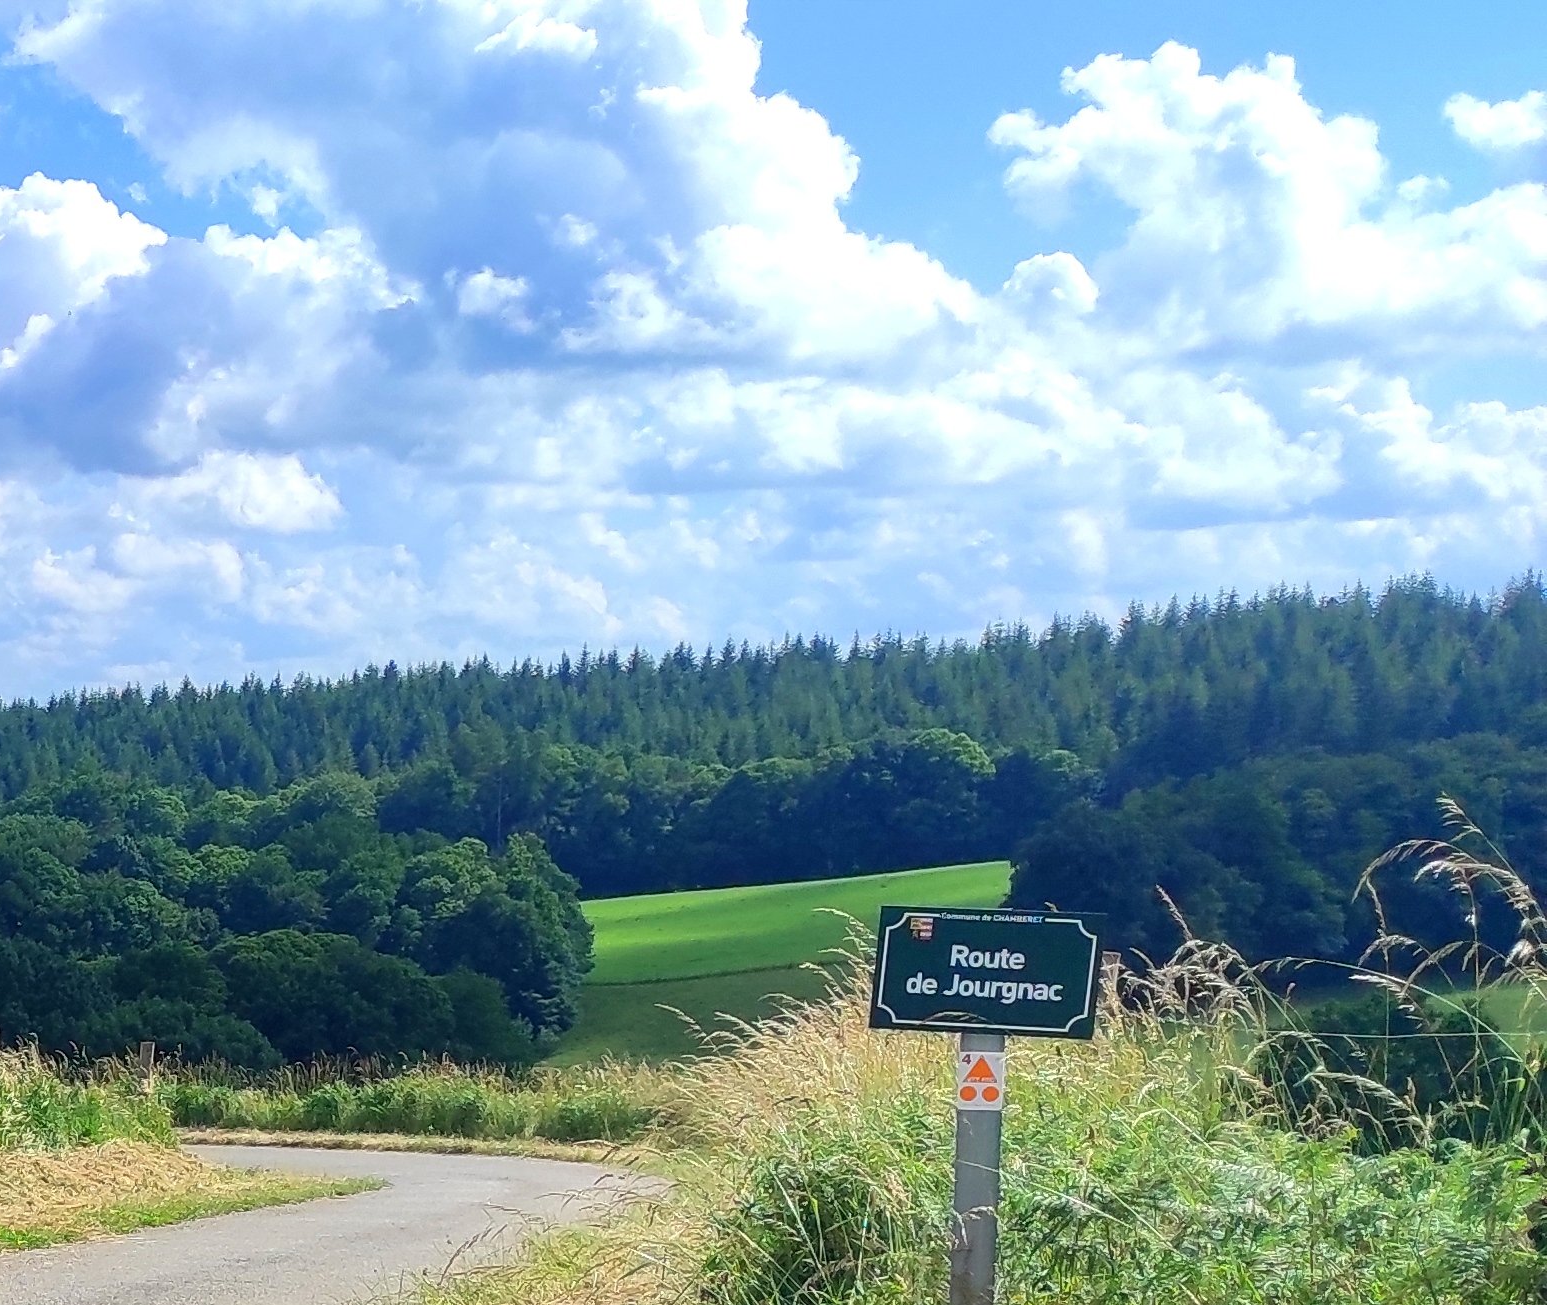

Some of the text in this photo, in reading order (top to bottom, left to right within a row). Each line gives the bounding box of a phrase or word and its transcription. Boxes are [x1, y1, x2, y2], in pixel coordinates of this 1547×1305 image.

[993, 914, 1045, 923] CHAMBERET
[949, 944, 1026, 970] Route
[906, 972, 1064, 1005] de Jourgnac
[961, 1053, 972, 1066] 4
